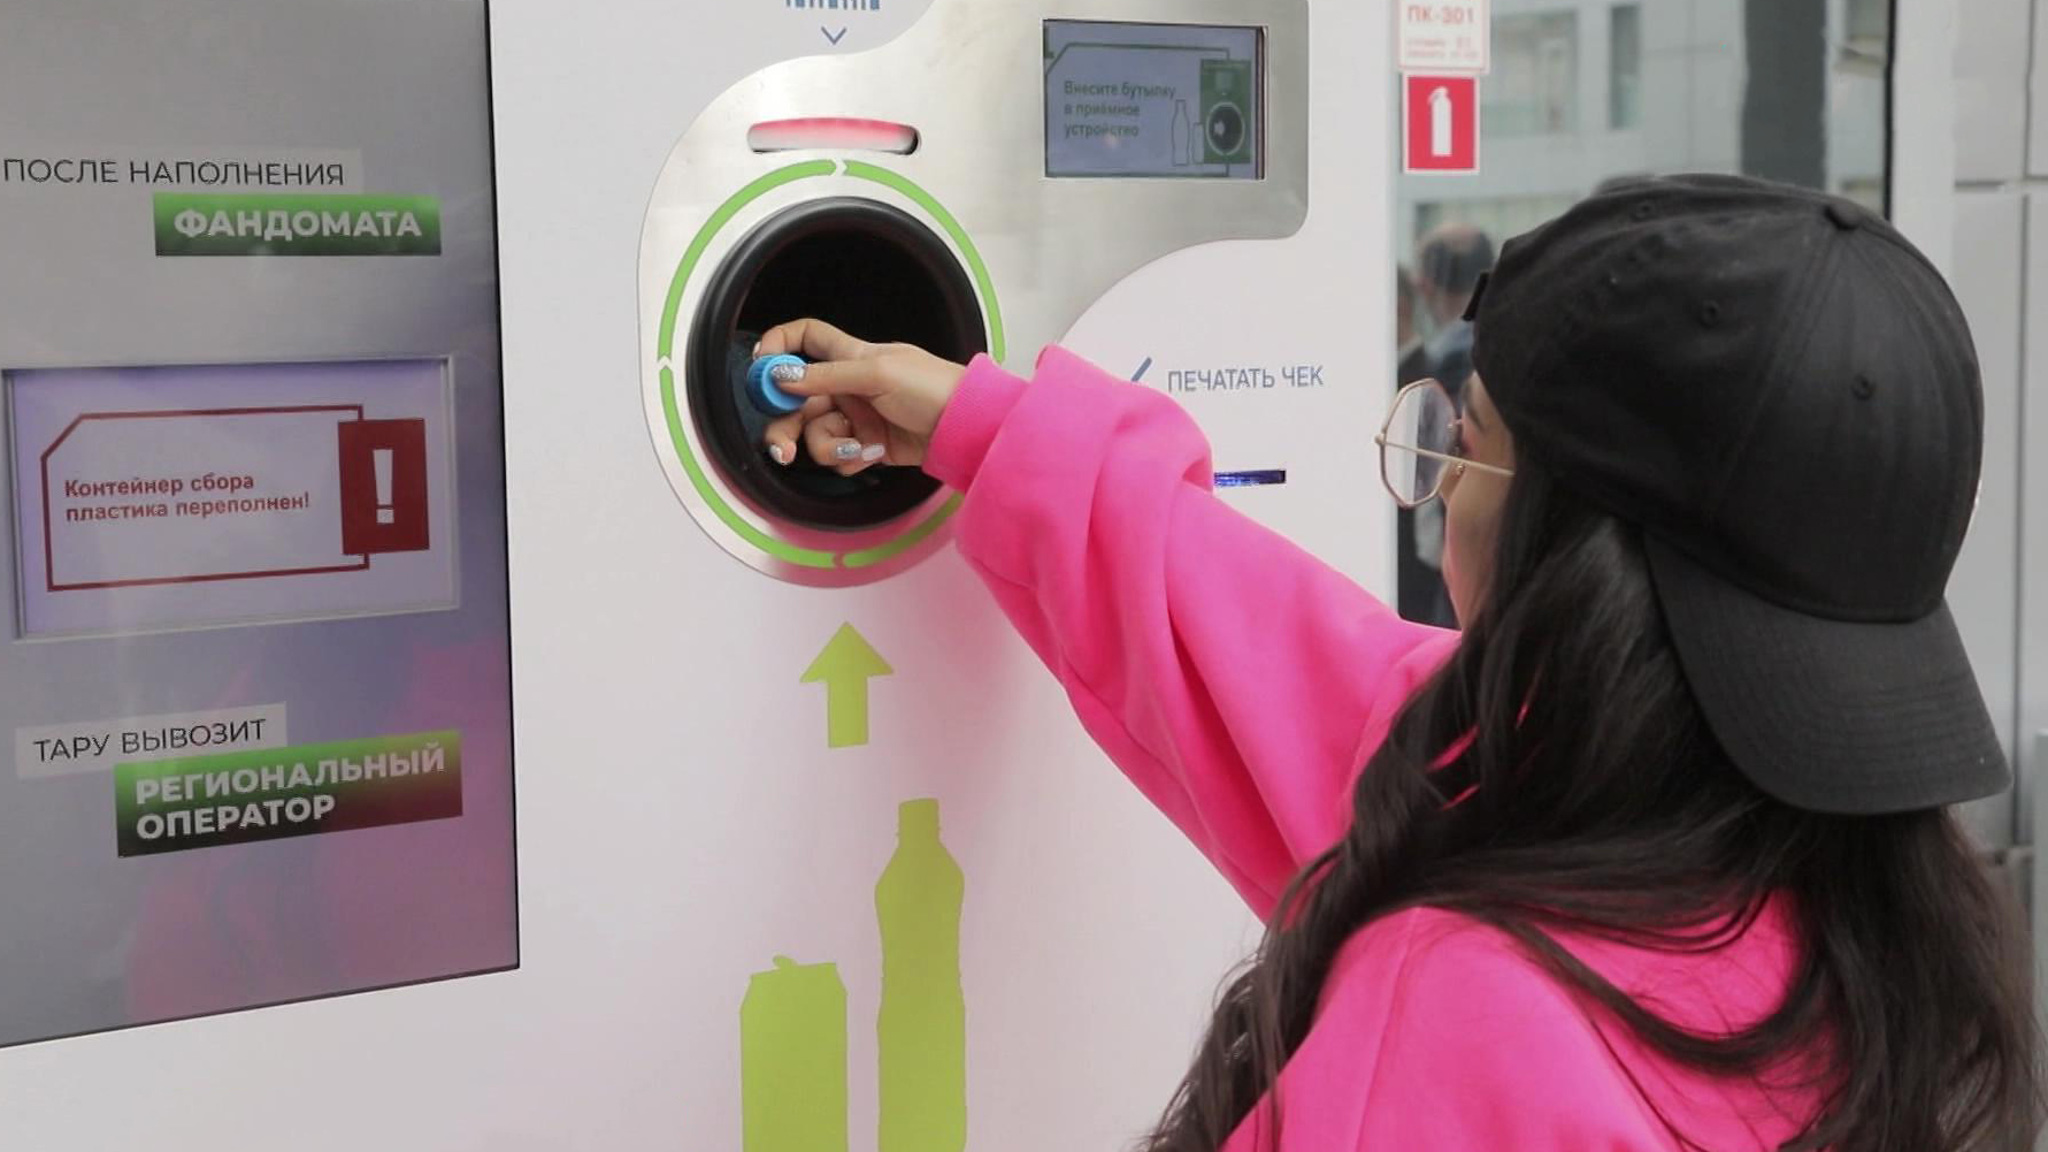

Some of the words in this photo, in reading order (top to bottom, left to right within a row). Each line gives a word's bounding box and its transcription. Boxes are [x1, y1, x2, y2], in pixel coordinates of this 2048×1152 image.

[1064, 80, 1117, 96] Внесите
[1121, 82, 1176, 99] бутылку
[1064, 104, 1072, 114] в
[1064, 122, 1139, 138] устройство
[3, 158, 118, 184] ПОСЛЕ
[130, 160, 344, 186] НАПОЛНЕНИЯ
[173, 208, 421, 241] ФАНДОМАТА
[1167, 368, 1275, 393] ПЕЧАТАТЬ
[1282, 365, 1324, 388] ЧЕК
[64, 475, 184, 499] Контейнер
[190, 472, 254, 494] сбора
[66, 500, 168, 521] пластика
[175, 491, 310, 519] переполнен!
[33, 734, 110, 763] ТАРУ
[121, 718, 267, 754] ВЫВОЗИТ
[136, 741, 446, 804] РЕГИОНАЛЬНЫЙ
[136, 795, 336, 839] ОПЕРАТОР
